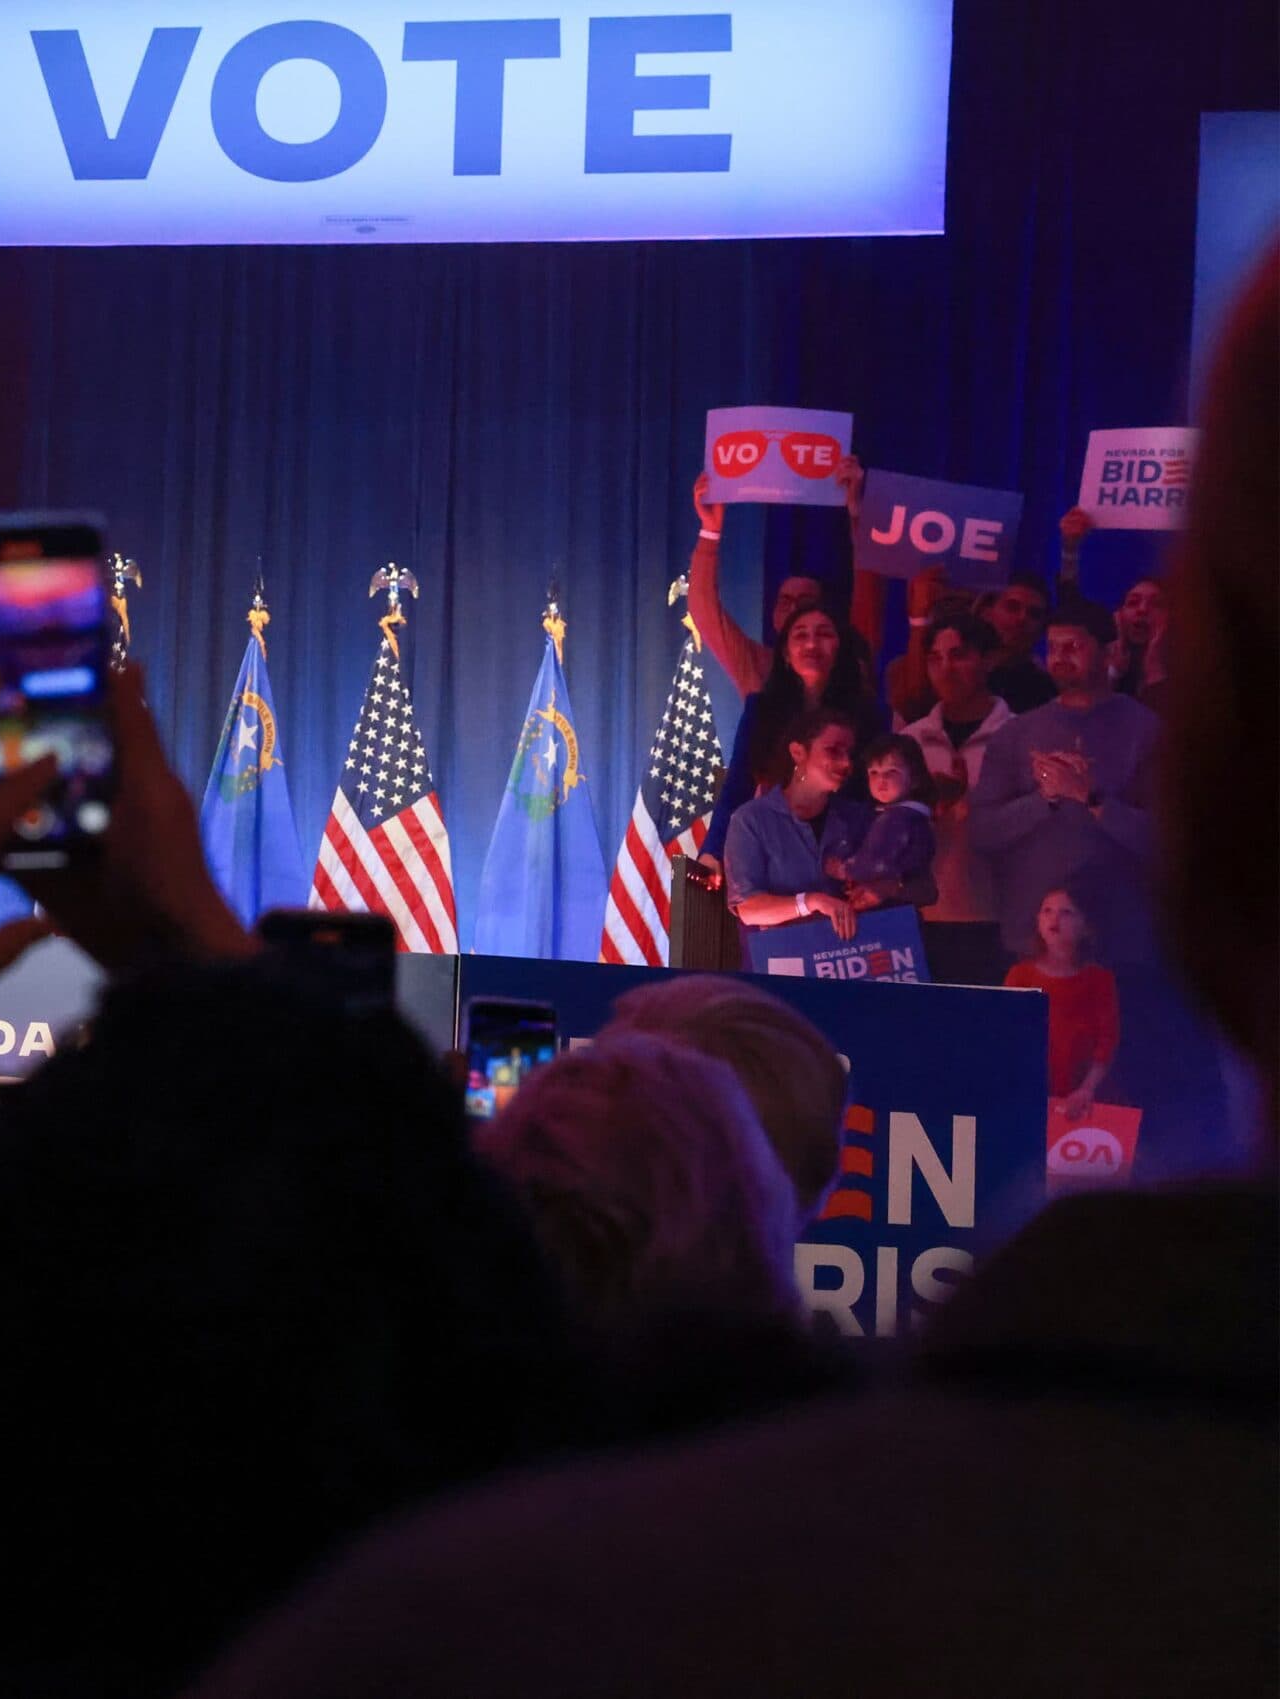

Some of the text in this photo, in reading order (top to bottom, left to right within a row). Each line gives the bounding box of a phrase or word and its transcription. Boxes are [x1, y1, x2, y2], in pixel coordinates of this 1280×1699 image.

[29, 13, 733, 183] VOTE
[1105, 448, 1156, 457] NEVADA
[870, 505, 1003, 562] JOE
[813, 942, 882, 960] NEVADA FOR
[815, 948, 915, 979] BIDEN
